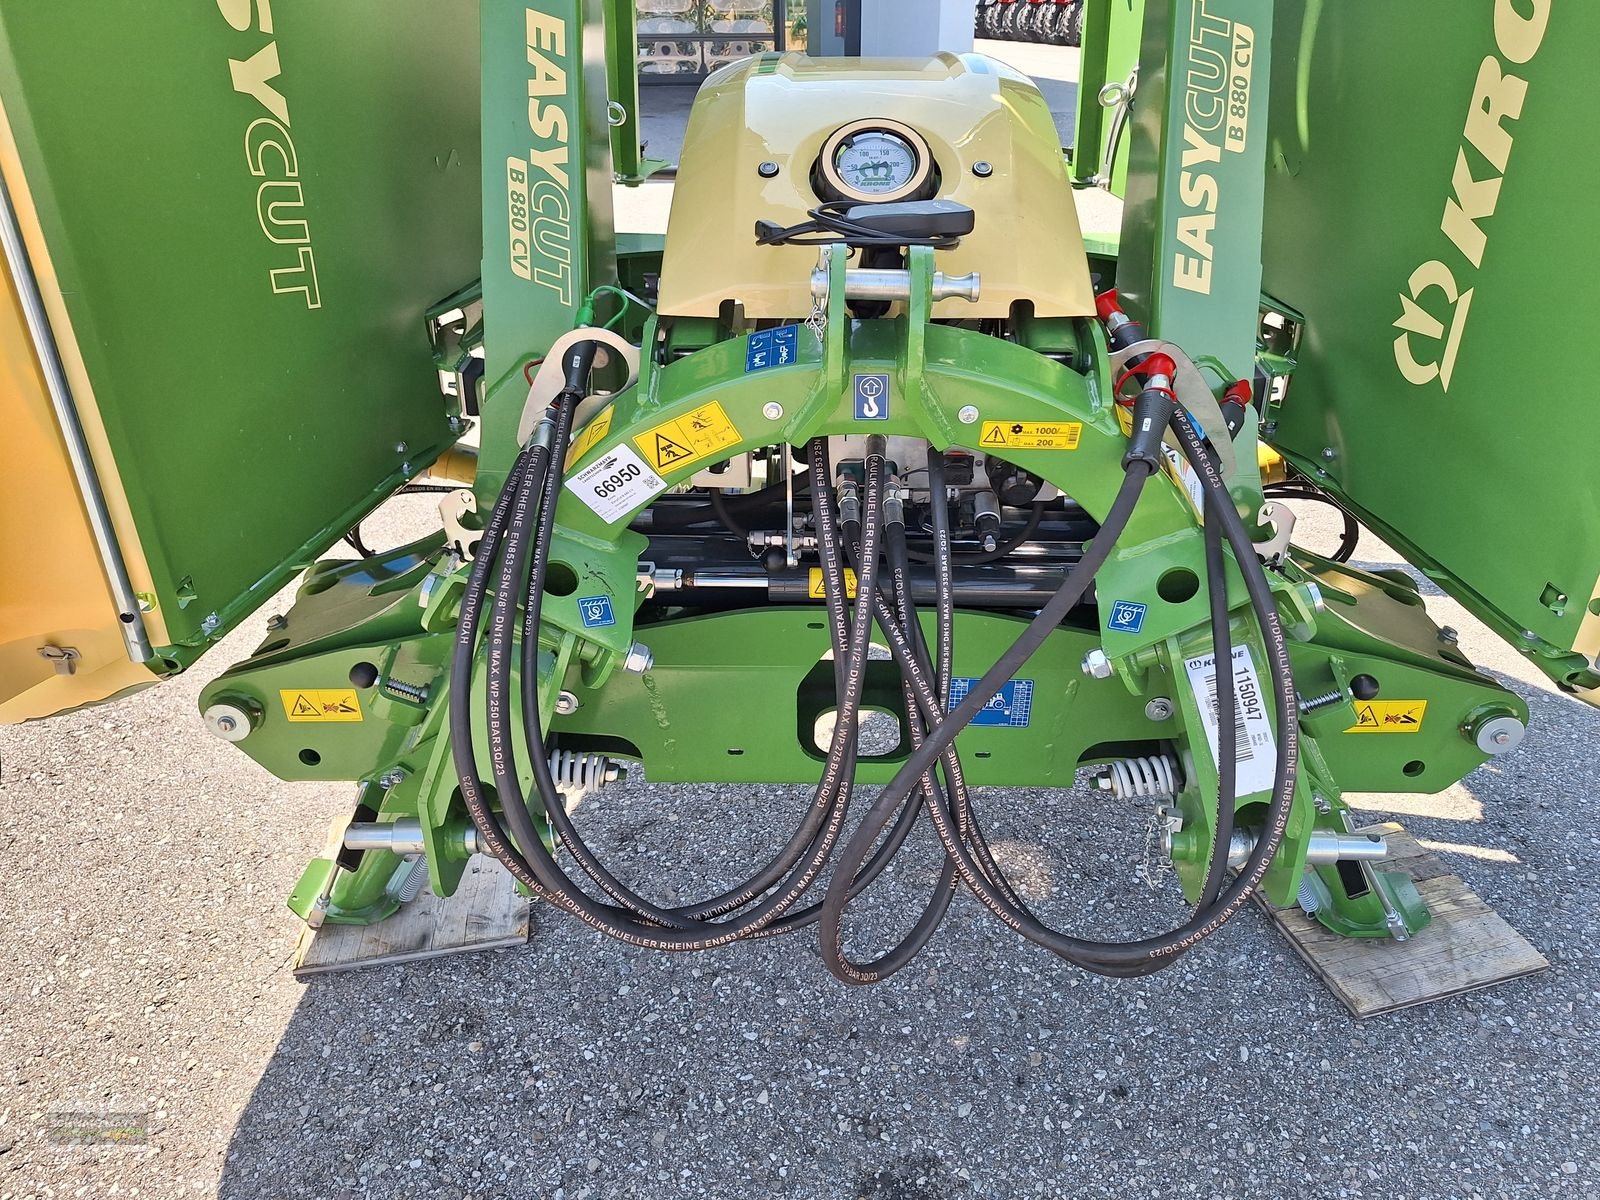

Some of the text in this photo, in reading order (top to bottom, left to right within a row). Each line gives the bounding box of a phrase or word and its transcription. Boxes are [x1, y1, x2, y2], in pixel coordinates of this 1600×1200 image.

[1228, 32, 1251, 142] B 880 CV
[526, 7, 572, 306] EASYCUT
[1173, 0, 1231, 295] EASYCUT
[509, 168, 528, 271] B 880 CV
[549, 444, 561, 470] RHEINE
[1174, 408, 1222, 488] WP 275 BAR 3Q/23
[524, 446, 542, 490] MUELLER
[594, 464, 641, 498] 66950
[816, 457, 826, 487] EN853
[545, 474, 554, 495] EN853
[513, 490, 530, 527] RHEINE
[818, 490, 832, 529] RHEINE
[866, 488, 878, 537] MUELLER
[460, 580, 481, 644] HYDRAULIK
[478, 530, 498, 580] MUELLER
[492, 494, 512, 531] RHEINE
[506, 468, 522, 493] EN853
[506, 532, 520, 566] EN853
[824, 533, 840, 584] MUELLER
[862, 538, 874, 581] RHEINE
[502, 567, 512, 589] 2SN
[532, 568, 538, 580] WP
[894, 568, 904, 598] 3Q/23
[858, 586, 870, 620] EN853
[943, 588, 949, 600] WP
[831, 588, 848, 652] HYDRAULIK
[878, 604, 891, 620] WP
[898, 598, 907, 620] BAR
[494, 616, 505, 645] DN16
[854, 622, 865, 645] 2SN
[1267, 612, 1290, 678] HYDRAULIK
[490, 649, 501, 678] MAX.
[902, 648, 920, 675] DN12
[490, 680, 500, 698] WP
[848, 669, 859, 697] DN12
[1234, 667, 1262, 722] 1150947
[490, 700, 499, 718] 250
[906, 692, 918, 719] DN12
[926, 696, 942, 722] 2SN
[1282, 677, 1296, 732] MUELLER
[491, 720, 501, 744] BAR
[837, 728, 848, 745] WP
[494, 746, 505, 776] 3Q/23
[832, 745, 844, 762] 275
[948, 750, 963, 786] RHEINE
[1286, 734, 1297, 774] RHEINE
[826, 763, 838, 783] BAR
[462, 775, 478, 806] 3Q/23
[816, 783, 832, 808] 3Q/23
[1280, 780, 1294, 812] EN853
[472, 804, 486, 823] BAR
[928, 800, 949, 838] RHEINE
[957, 786, 968, 832] MUELLER
[480, 822, 495, 840] 275
[1274, 815, 1287, 837] 2SN
[490, 840, 505, 857] WP
[944, 838, 976, 883] MUELLER
[556, 889, 609, 932] HYDRAULIK
[608, 927, 658, 948] MUELLER
[660, 941, 700, 950] RHEINE
[705, 933, 738, 948] EN853
[738, 922, 759, 938] 2SN
[776, 890, 800, 912] DN16
[797, 866, 818, 892] MAX.
[812, 850, 826, 866] WP
[822, 833, 834, 850] 250
[830, 811, 842, 832] BAR
[836, 782, 849, 810] 3Q/23
[560, 830, 588, 866] HYDRAULIK
[586, 866, 613, 894] MUELLER
[612, 892, 637, 911] RHEINE
[637, 908, 659, 923] EN853
[1250, 858, 1270, 884] DN12
[520, 872, 544, 893] DN12
[702, 890, 755, 921] HYDRAULIK
[972, 878, 1021, 930] HYDRAULIK
[1220, 908, 1234, 923] WP
[754, 930, 770, 938] BAR
[772, 926, 793, 934] 2Q/23
[1180, 932, 1203, 948] BAR
[1202, 920, 1220, 936] 275
[1149, 944, 1181, 958] 3Q/23
[848, 968, 860, 980] BAR
